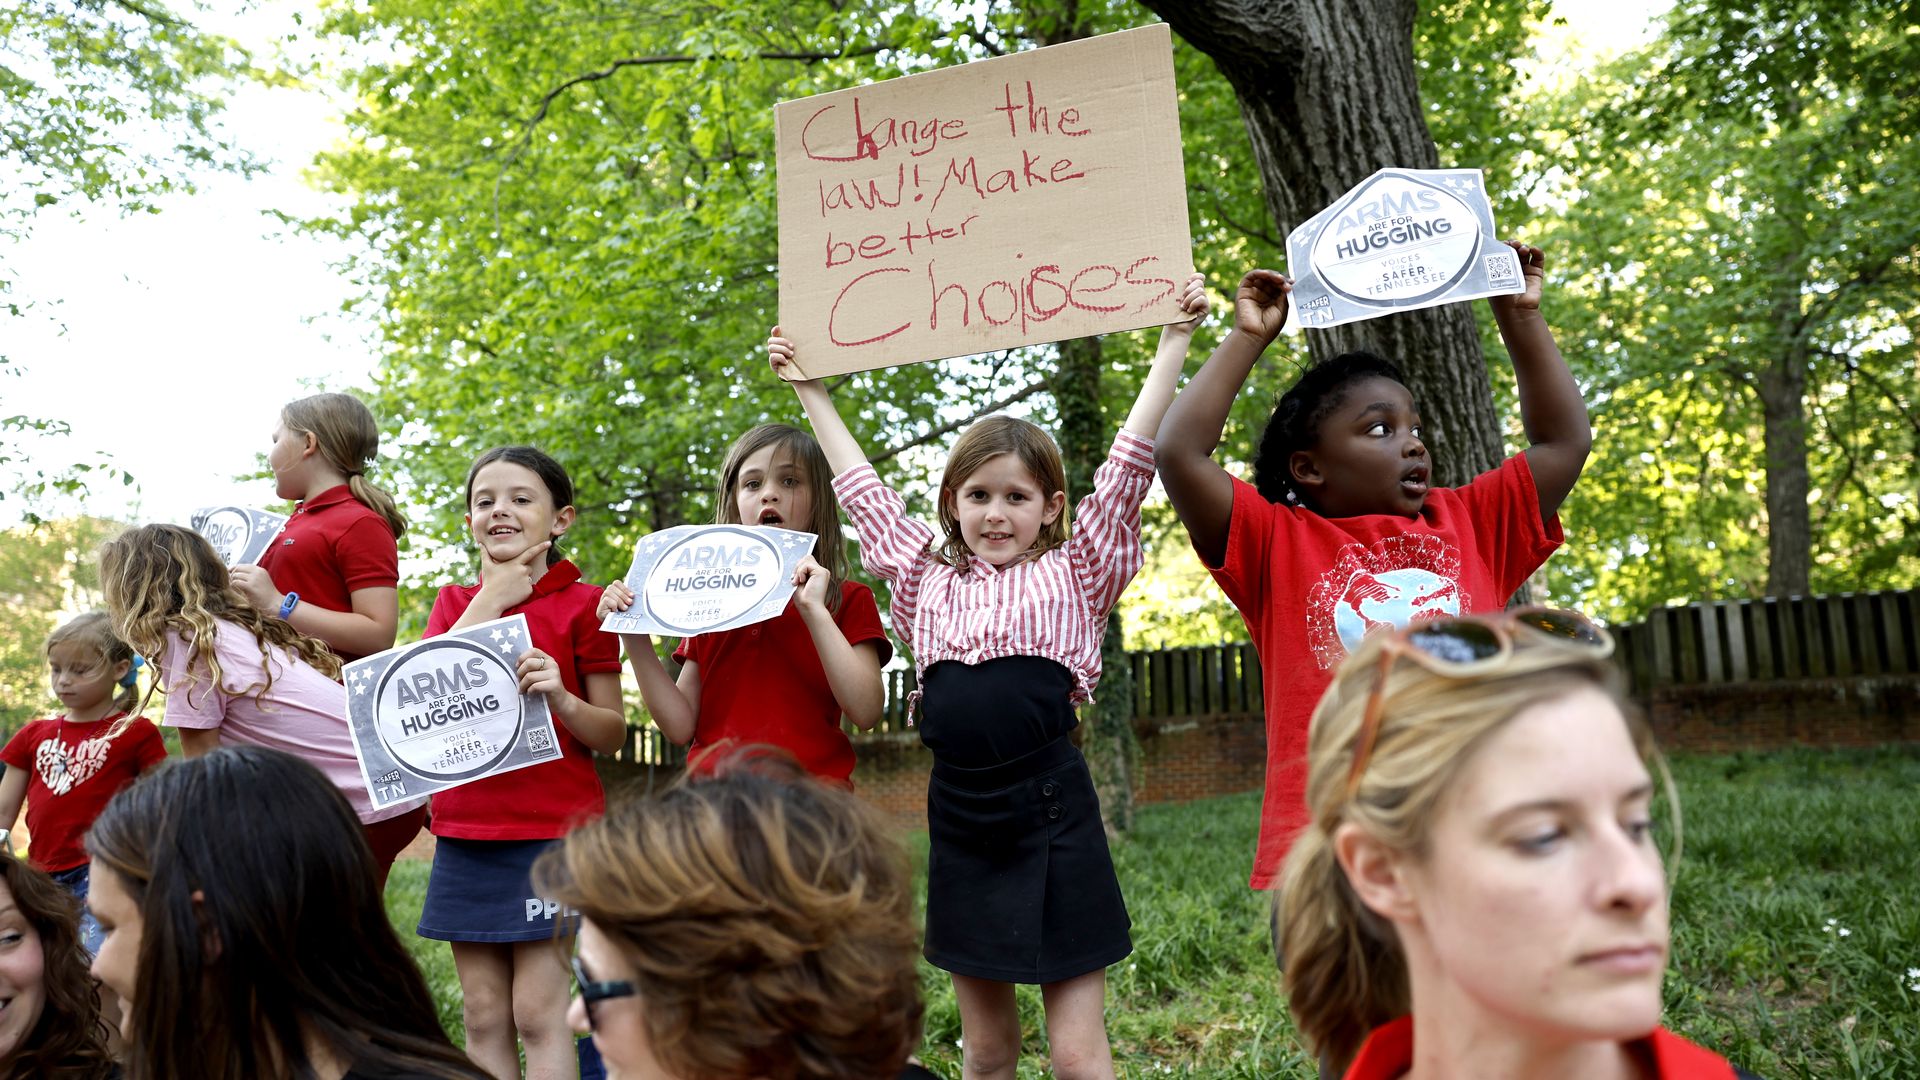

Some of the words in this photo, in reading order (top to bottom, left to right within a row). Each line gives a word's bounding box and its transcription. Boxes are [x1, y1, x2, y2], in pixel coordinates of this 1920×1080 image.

[802, 97, 968, 161] Change
[995, 80, 1091, 138] the
[1336, 189, 1441, 236] ARMS
[1368, 219, 1389, 233] ARE
[1391, 215, 1413, 229] FOR
[825, 215, 980, 268] better
[1336, 218, 1452, 260] HUGGING
[1381, 253, 1421, 267] VOICES
[1366, 271, 1446, 295] TENNESSEE
[1382, 266, 1426, 282] SAFER
[1303, 307, 1335, 325] TN
[672, 545, 764, 570] ARMS
[714, 567, 732, 575] FOR
[665, 573, 757, 592] HUGGING
[687, 608, 721, 617] SAFER
[612, 617, 640, 631] TN
[397, 657, 489, 710] ARMS
[428, 699, 446, 710] ARE
[447, 693, 467, 704] FOR
[401, 693, 500, 737] HUGGING
[443, 729, 476, 744] VOICES
[432, 743, 499, 770] TENNESSEE
[445, 740, 482, 758] SAFER
[380, 770, 401, 783] SAFER
[377, 781, 407, 801] TN
